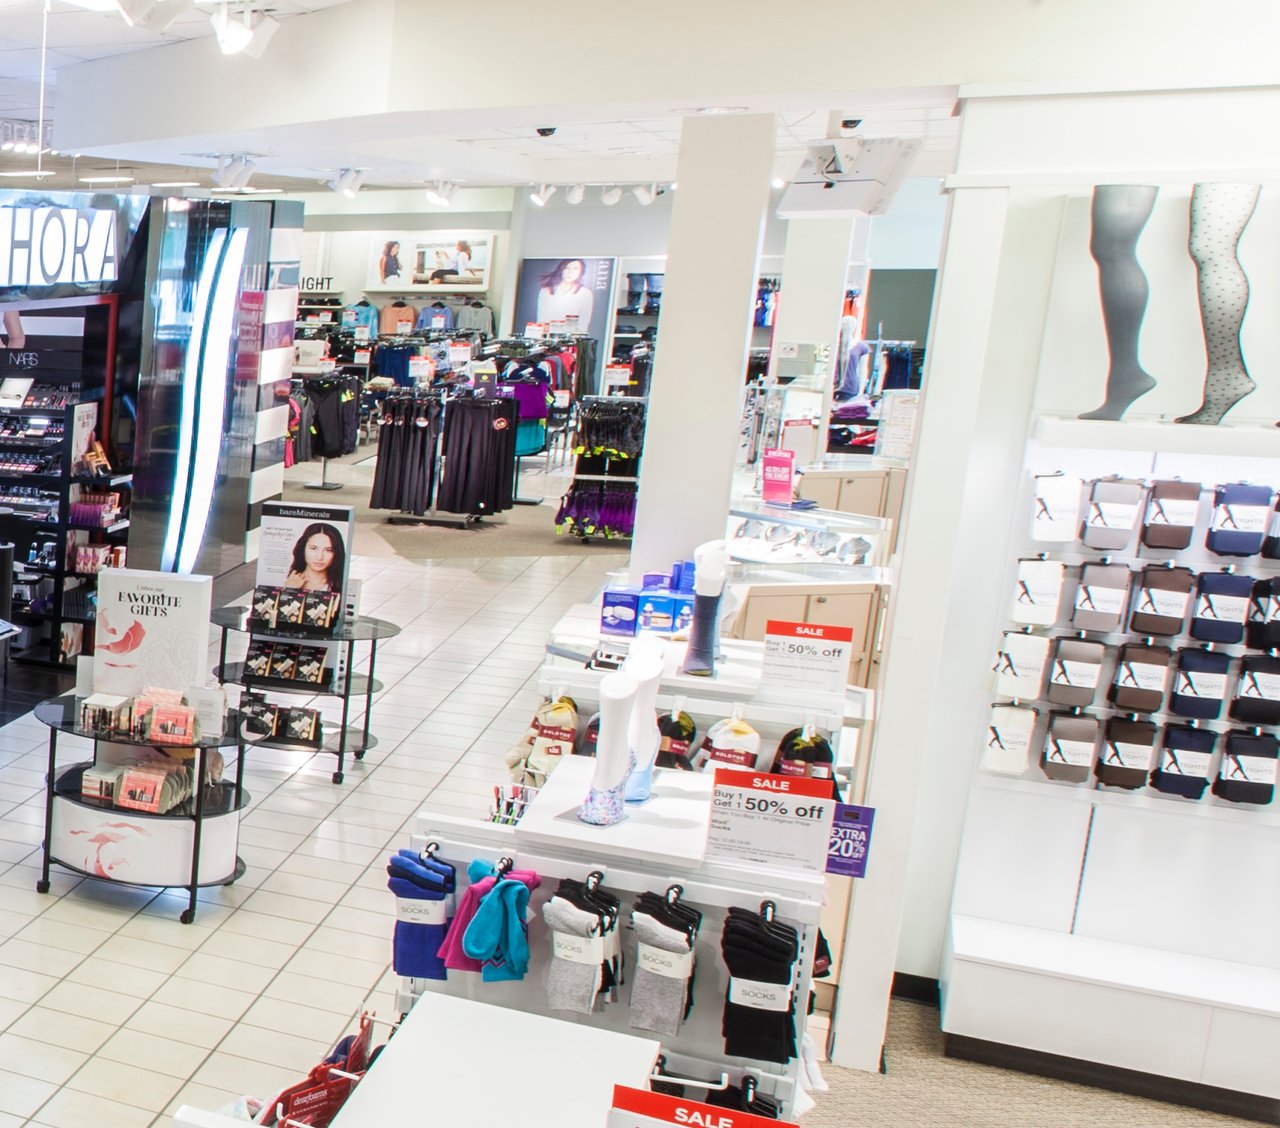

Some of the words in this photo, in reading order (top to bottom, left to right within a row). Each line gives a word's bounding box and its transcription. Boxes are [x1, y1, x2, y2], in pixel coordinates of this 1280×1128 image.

[298, 277, 333, 290] IGHT
[9, 352, 40, 366] NARS
[279, 508, 330, 518] bareMinerals
[118, 592, 182, 607] FAVORITE
[130, 605, 168, 617] GIFTS
[1158, 602, 1184, 610] TIGHTS
[1216, 605, 1243, 613] TIGHTS
[796, 626, 824, 636] SALE
[788, 644, 817, 656] 50%
[822, 648, 842, 657] off
[1136, 674, 1163, 682] TIGHTS
[1260, 683, 1280, 691] TIGHT
[543, 729, 570, 738] GOLDTOE
[672, 743, 688, 751] GOLDT
[715, 751, 744, 761] GOLDTOE
[1122, 753, 1148, 761] TIGHTS
[1181, 764, 1208, 772] TIGHTS
[1246, 766, 1274, 774] TIGHTS
[752, 777, 790, 791] SALE
[714, 790, 735, 800] Buy
[714, 799, 731, 807] Get
[745, 797, 788, 815] 50%
[795, 805, 824, 819] off
[831, 827, 865, 841] EXTRA
[829, 838, 865, 857] 20%
[401, 906, 430, 916] SOCKS
[556, 941, 583, 954] SOCKS
[642, 953, 673, 968] SOCKS
[741, 989, 776, 1001] SOCKS
[293, 1089, 328, 1106] dearfoams
[674, 1107, 734, 1128] SALE
